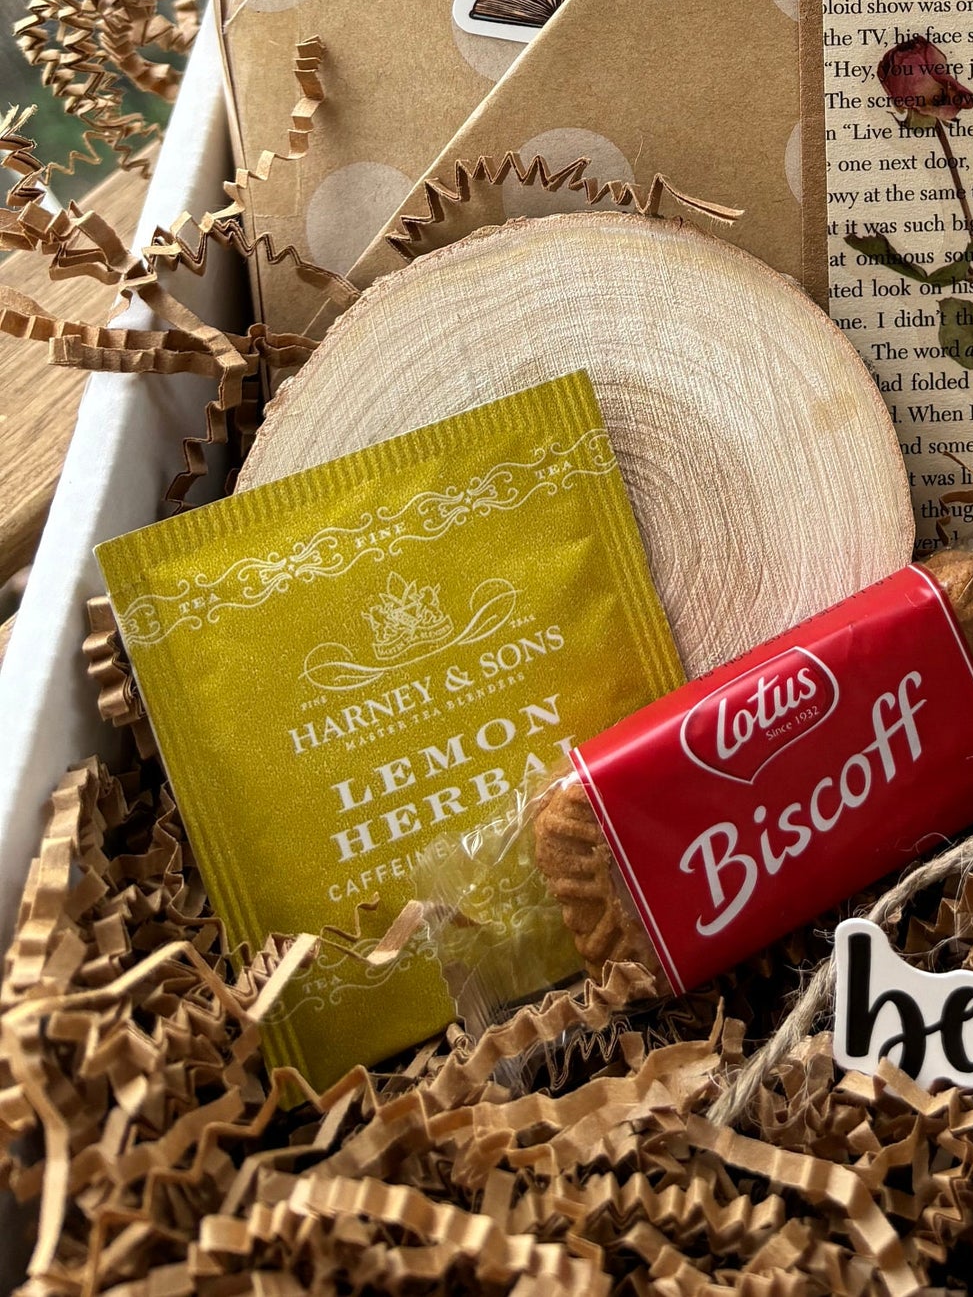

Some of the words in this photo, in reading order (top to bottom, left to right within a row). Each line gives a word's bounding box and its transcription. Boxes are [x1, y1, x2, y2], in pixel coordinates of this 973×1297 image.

[919, 1, 950, 13] was
[824, 29, 852, 47] the
[858, 28, 889, 50] TV,
[926, 26, 962, 44] face
[825, 60, 875, 83] “Hey,
[883, 65, 913, 82] you
[919, 63, 963, 76] were
[825, 91, 861, 109] The
[867, 96, 925, 108] screen
[843, 122, 892, 140] “Live
[838, 160, 871, 172] one
[879, 156, 917, 171] next
[925, 151, 969, 173] door,
[864, 189, 880, 203] at
[886, 184, 914, 202] the
[920, 189, 965, 201] same
[846, 219, 858, 235] it
[864, 222, 897, 235] was
[903, 215, 944, 233] such
[872, 279, 911, 297] look
[920, 283, 942, 295] on
[877, 311, 885, 329] I
[894, 309, 947, 328] didn’t
[871, 342, 908, 361] The
[914, 341, 960, 359] word
[911, 372, 969, 391] folded
[909, 405, 963, 423] When
[178, 592, 221, 614] TEA
[354, 521, 408, 550] FINE
[534, 460, 573, 482] TEA
[288, 675, 434, 754] HARNEY
[444, 665, 474, 692] &
[479, 625, 565, 679] SONS
[344, 718, 407, 751] MASTER
[411, 708, 441, 725] TEA
[446, 672, 526, 711] BLENDERS
[716, 667, 817, 759] Lotus
[766, 720, 793, 741] Since
[794, 705, 820, 724] 1932
[331, 693, 563, 814] LEMON
[679, 670, 927, 936] Biscoff
[301, 974, 343, 994] TEA
